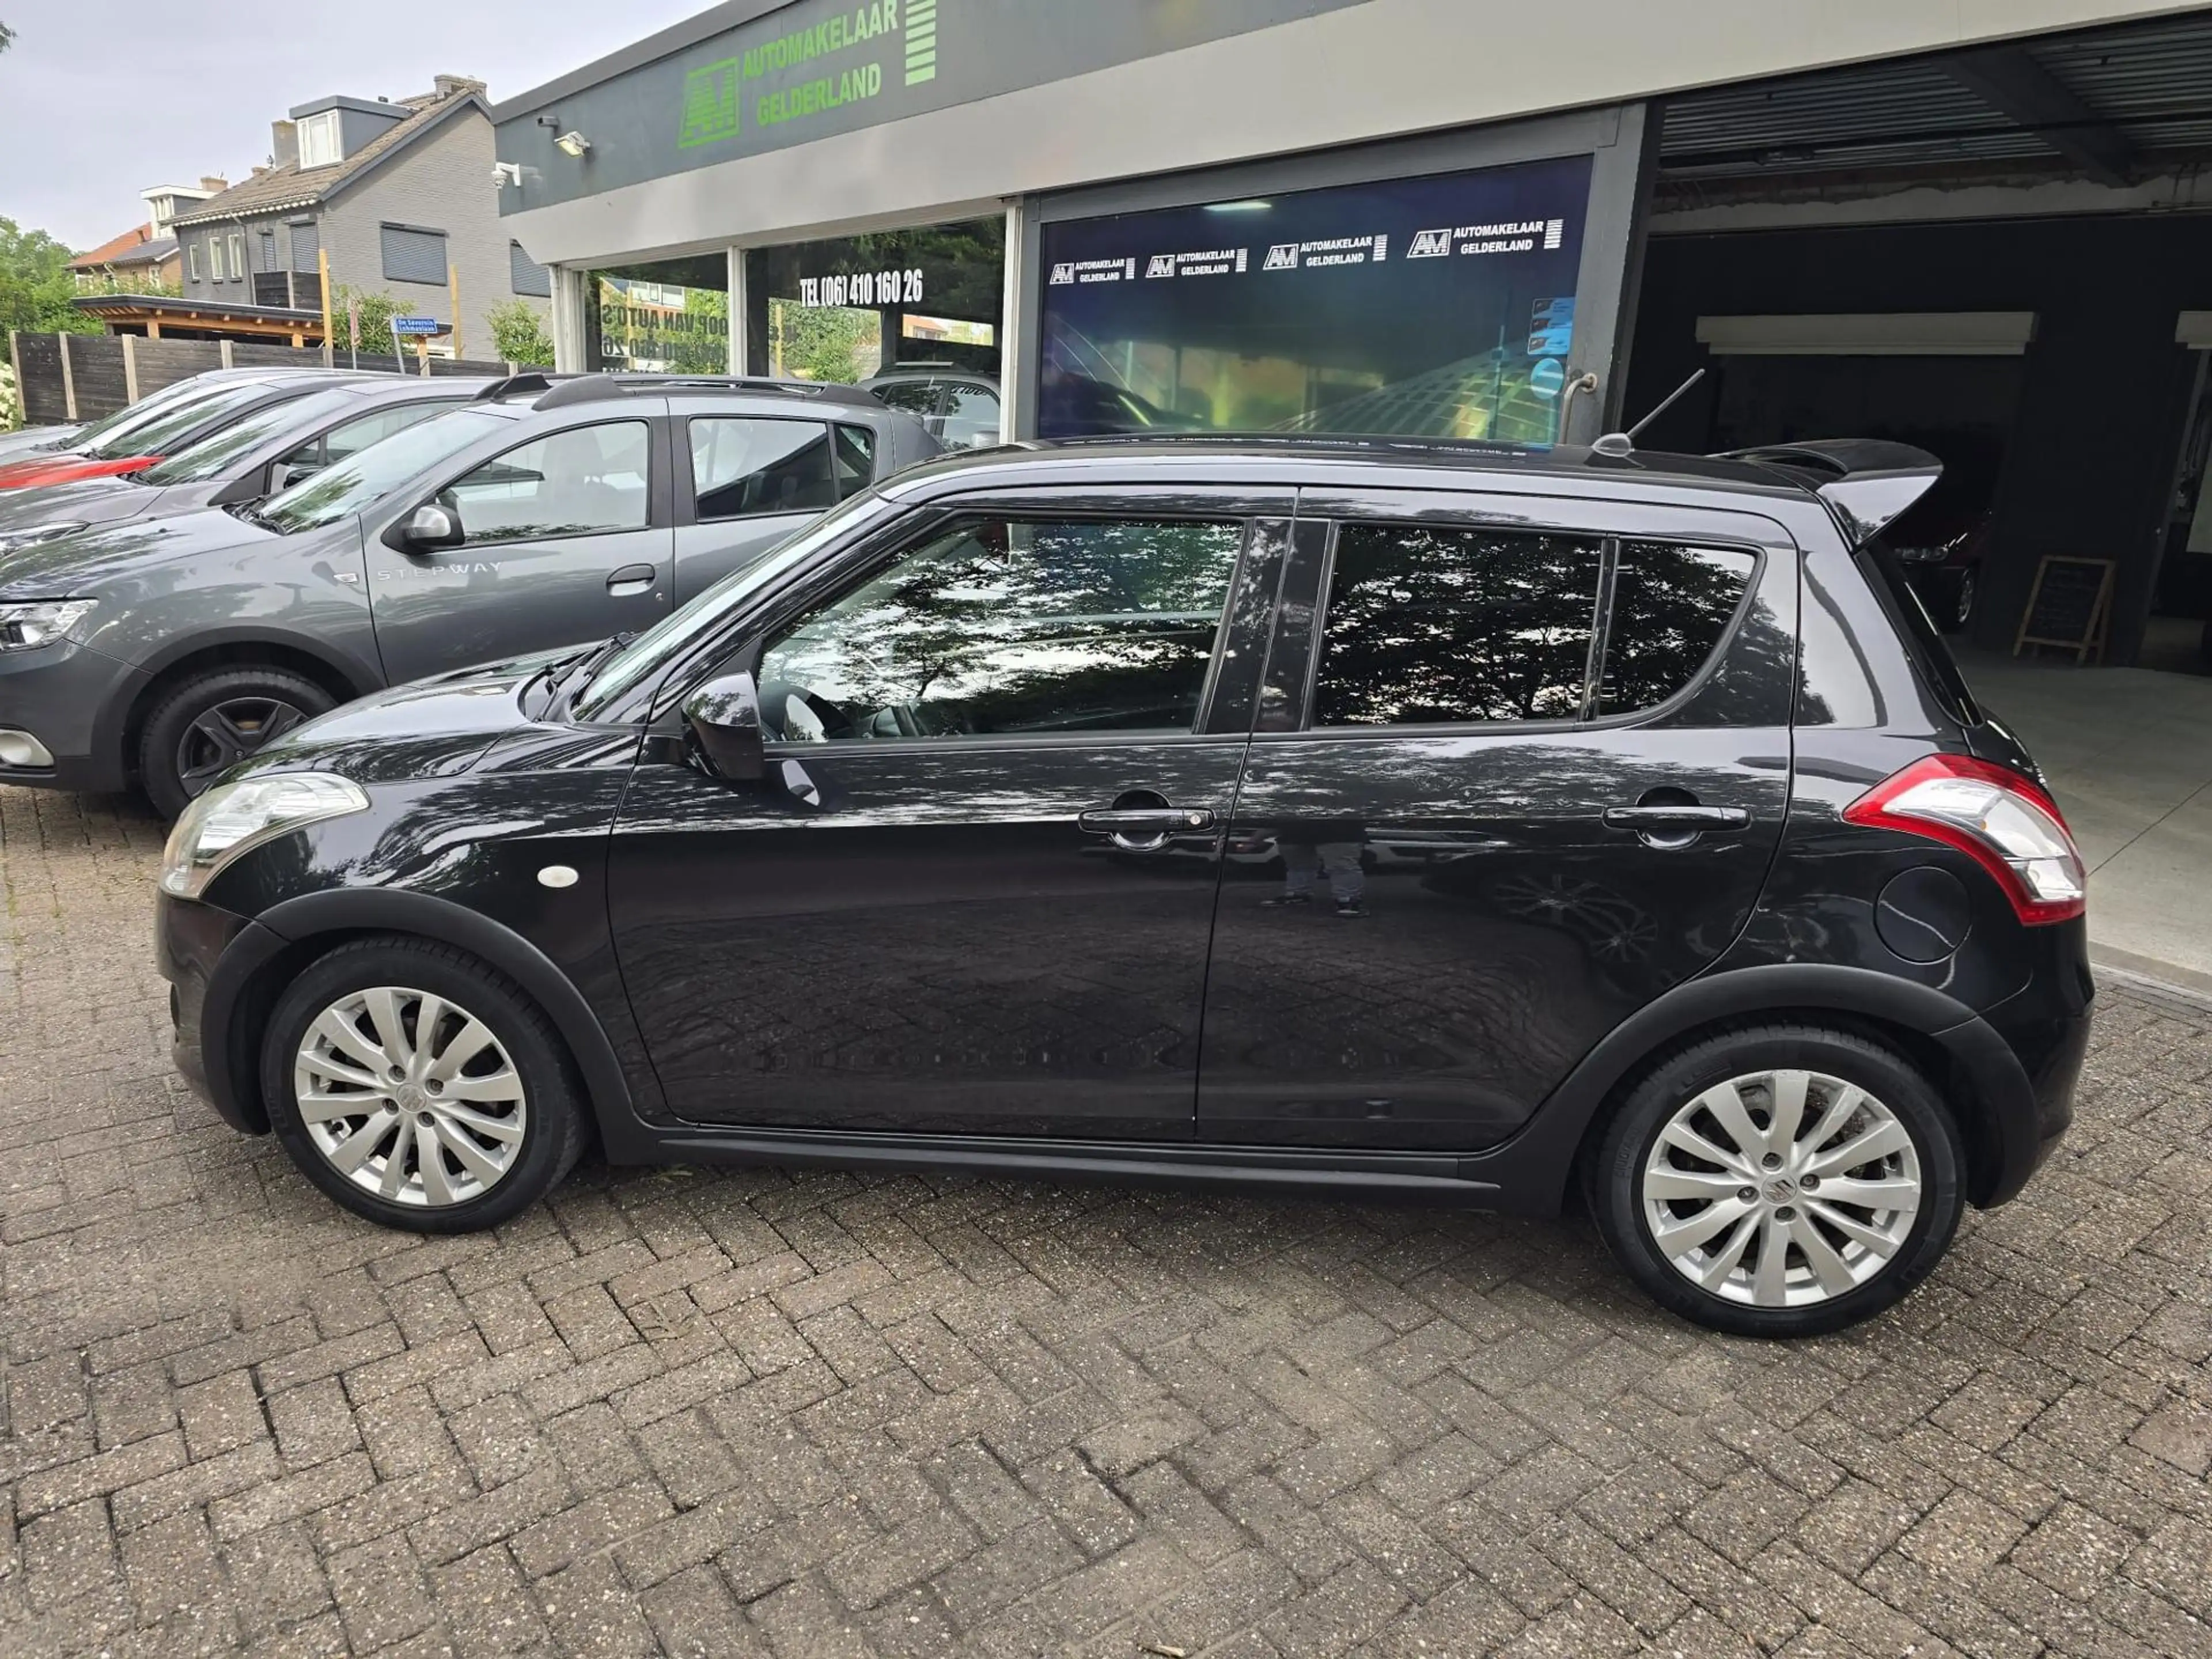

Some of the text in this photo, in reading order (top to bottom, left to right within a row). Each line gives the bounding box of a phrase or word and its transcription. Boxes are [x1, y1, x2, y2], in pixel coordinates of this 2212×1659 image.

[743, 0, 898, 81] AUTOMAKELAAR
[756, 63, 882, 126] GELDERLAND
[1453, 221, 1544, 238] AUTOMAKELAAR
[1300, 236, 1373, 252] AUTOMAKELAAR
[1460, 239, 1533, 255] GELDERLAND
[1176, 249, 1235, 262] AUTOMAKELAAR
[1306, 252, 1365, 267] GELDERLAND
[1075, 259, 1125, 271] AUTOMAKELAAR
[1181, 264, 1229, 276] GELDERLAND
[1080, 271, 1120, 282] GELDERLAND
[800, 268, 923, 307] TEL (06) 410 160 26
[378, 562, 503, 581] STEPWAY
